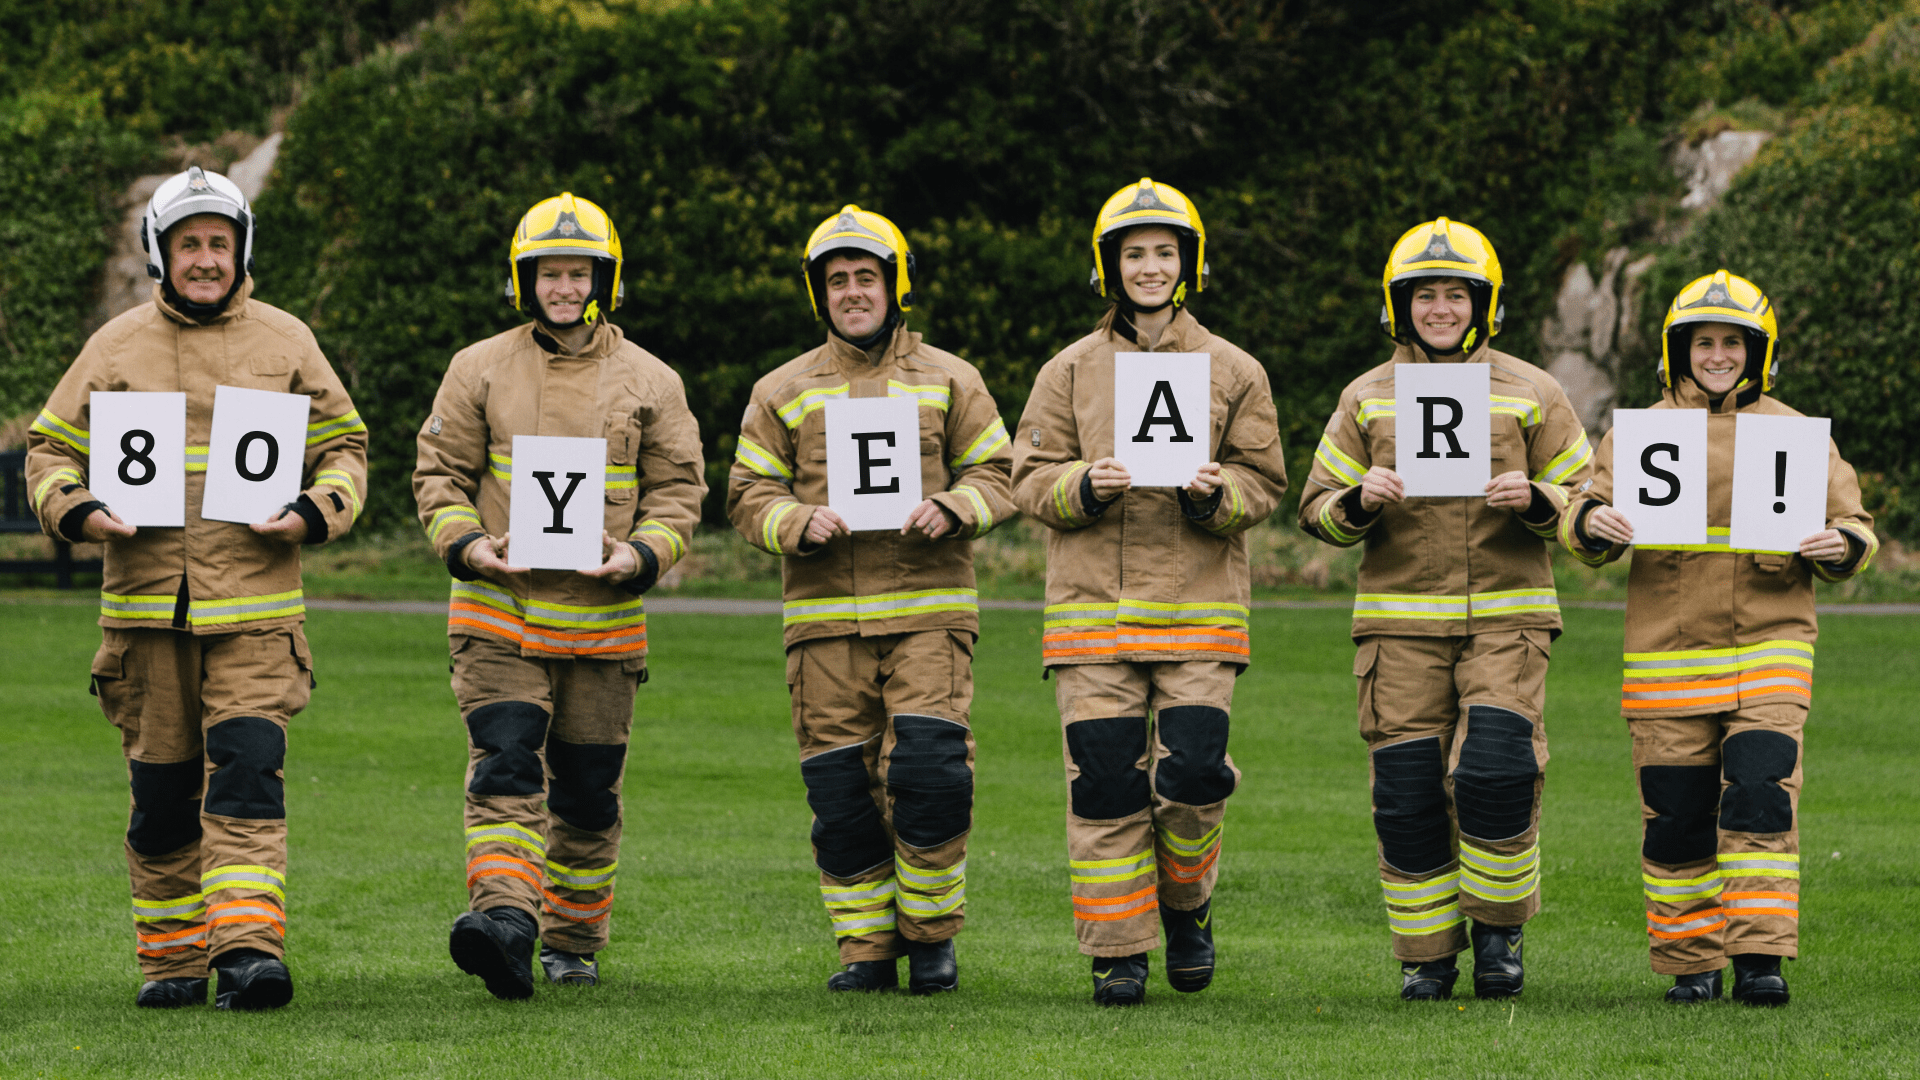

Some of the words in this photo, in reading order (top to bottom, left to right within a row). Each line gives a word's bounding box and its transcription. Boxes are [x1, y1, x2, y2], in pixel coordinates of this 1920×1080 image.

[1131, 380, 1194, 443] A
[1416, 396, 1470, 459] R
[117, 429, 157, 486] 8
[850, 431, 900, 495] E
[1638, 442, 1681, 507] S
[1772, 450, 1787, 514] !
[531, 471, 587, 534] Y
